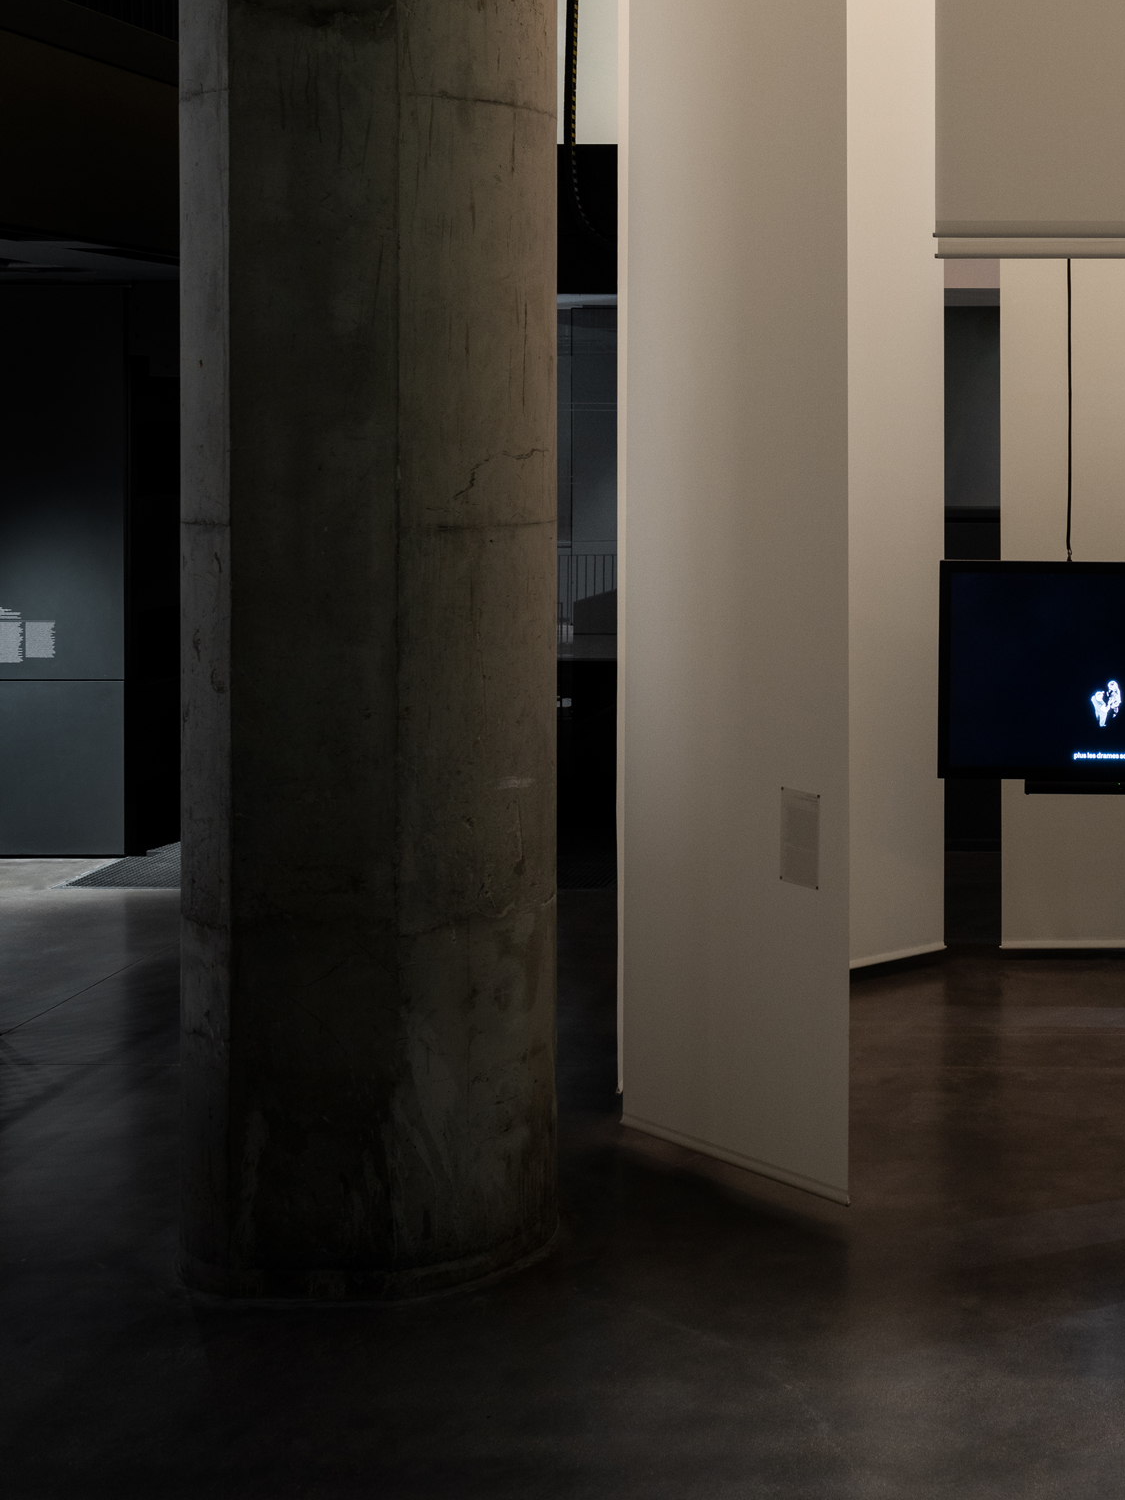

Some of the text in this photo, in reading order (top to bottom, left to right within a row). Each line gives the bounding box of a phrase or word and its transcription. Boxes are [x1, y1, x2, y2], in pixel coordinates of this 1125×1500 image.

[1073, 751, 1086, 760] plus
[1087, 751, 1096, 759] les
[1096, 751, 1119, 759] drames
